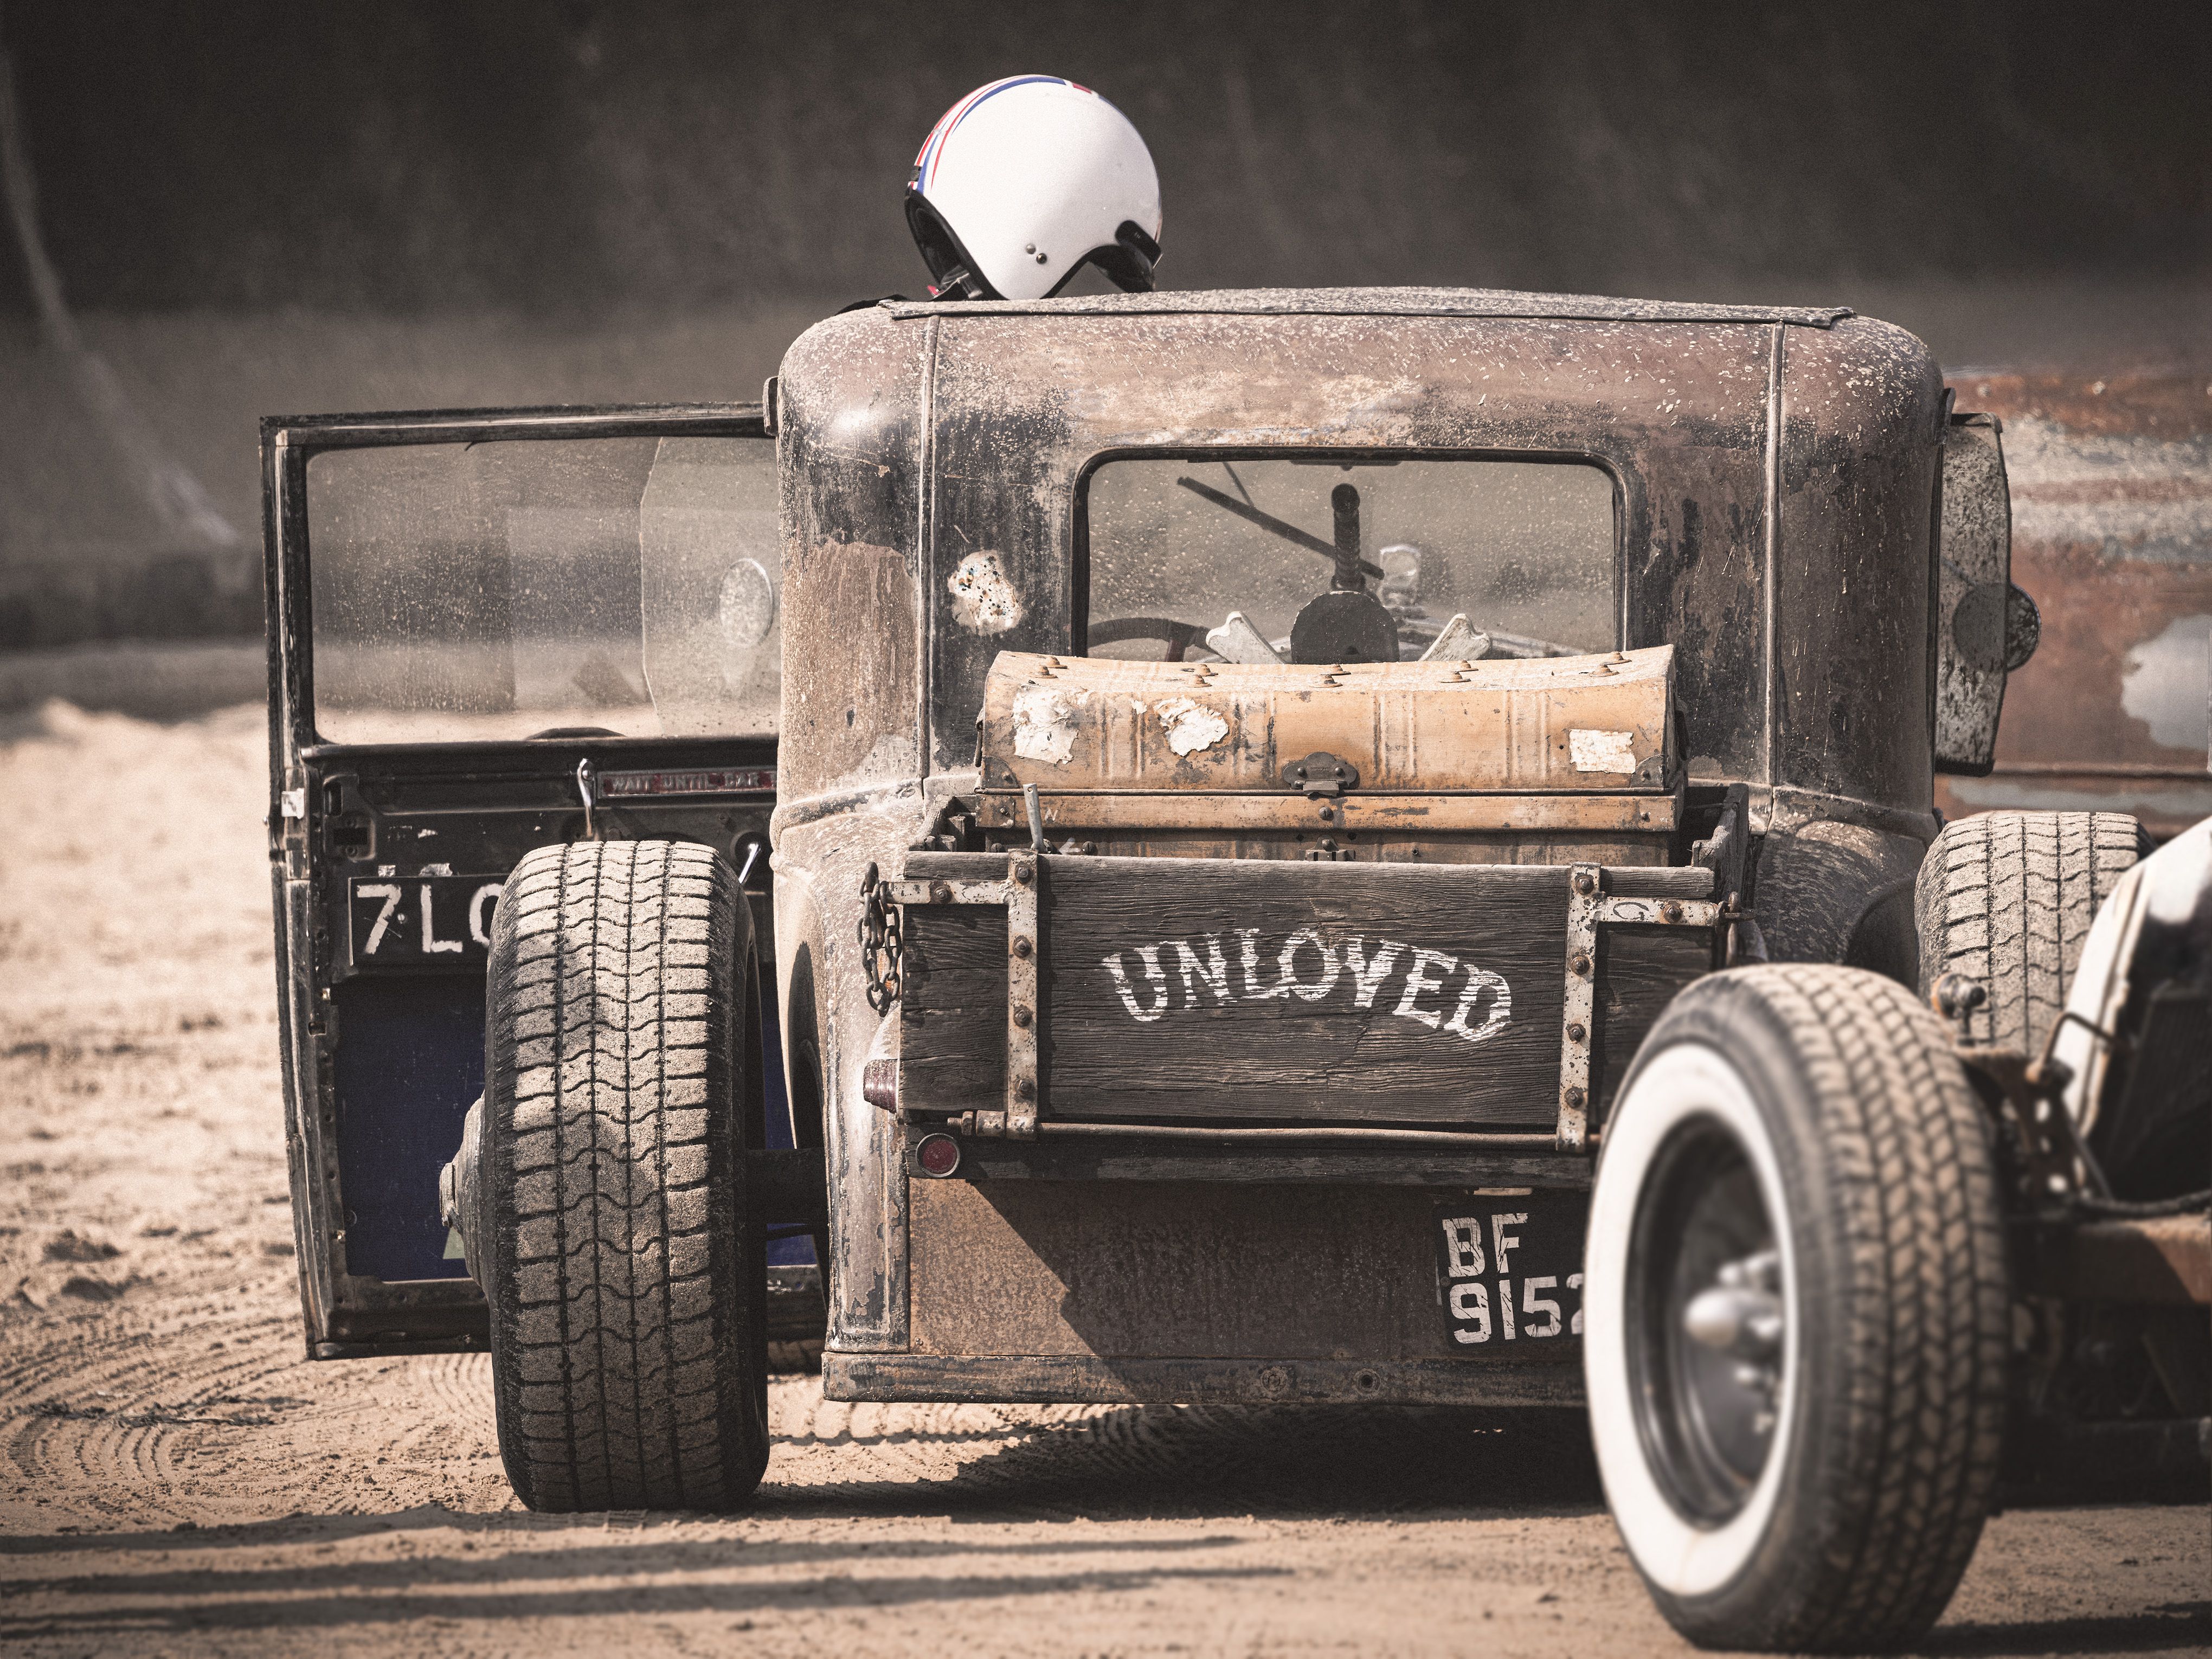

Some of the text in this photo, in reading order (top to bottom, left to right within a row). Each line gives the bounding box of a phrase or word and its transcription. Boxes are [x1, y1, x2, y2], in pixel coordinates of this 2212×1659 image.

[612, 774, 649, 791] WAIT
[661, 772, 715, 790] UNTIL
[724, 771, 759, 788] CAR
[1100, 928, 1513, 1041] UNLOVED
[1442, 1213, 1529, 1278] BF
